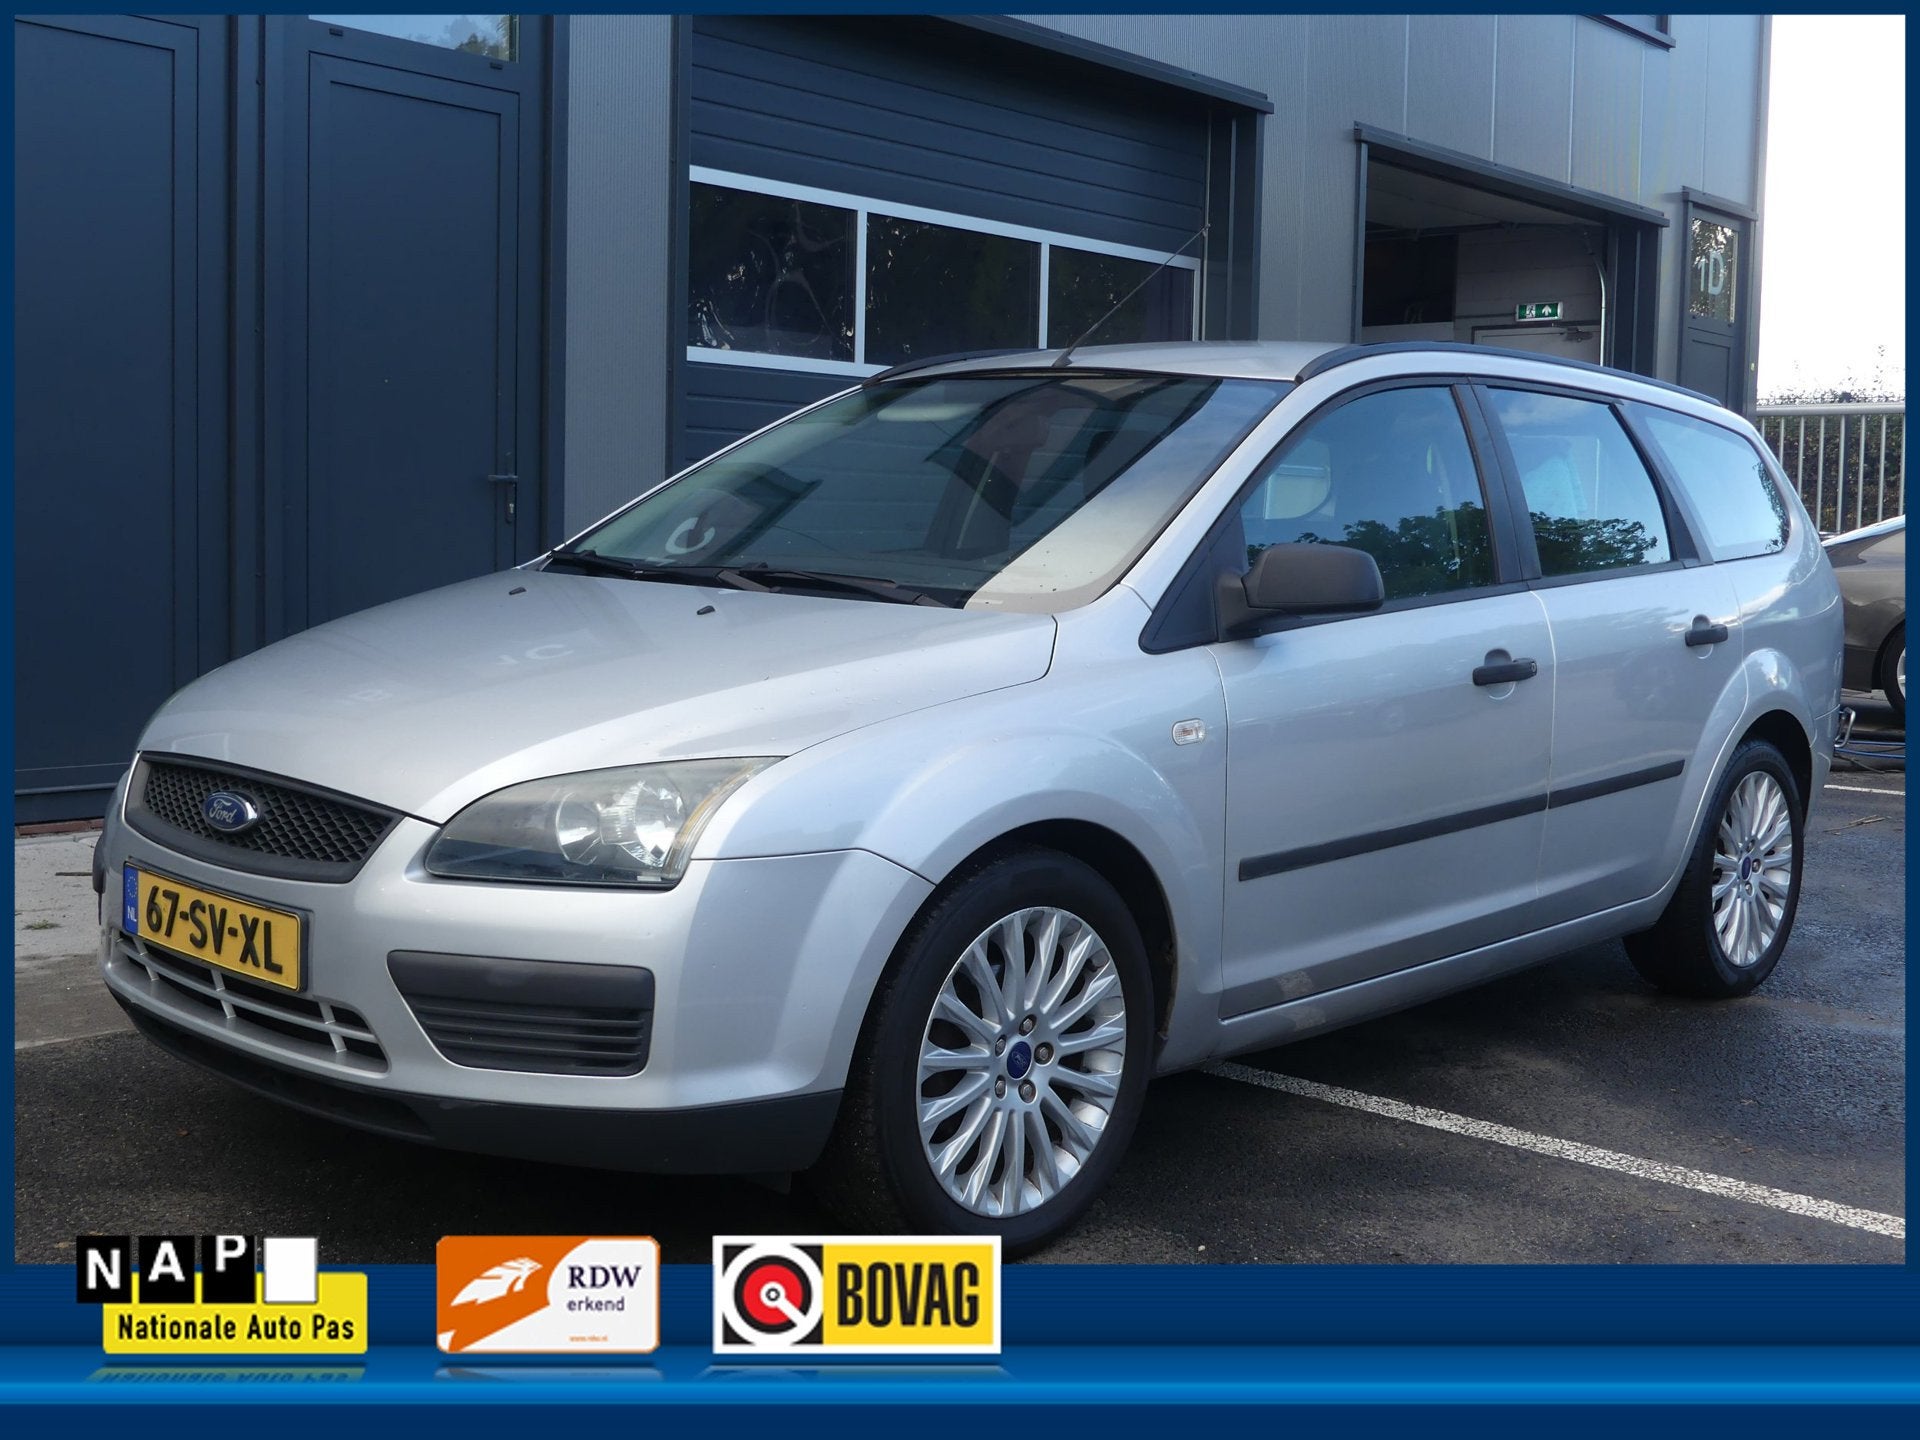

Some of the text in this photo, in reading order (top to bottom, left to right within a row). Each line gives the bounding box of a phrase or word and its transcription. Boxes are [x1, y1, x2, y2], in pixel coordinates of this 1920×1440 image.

[1697, 250, 1725, 296] 1D
[209, 799, 237, 824] Ford
[127, 907, 138, 922] NL
[146, 885, 283, 975] 67-SV-XL
